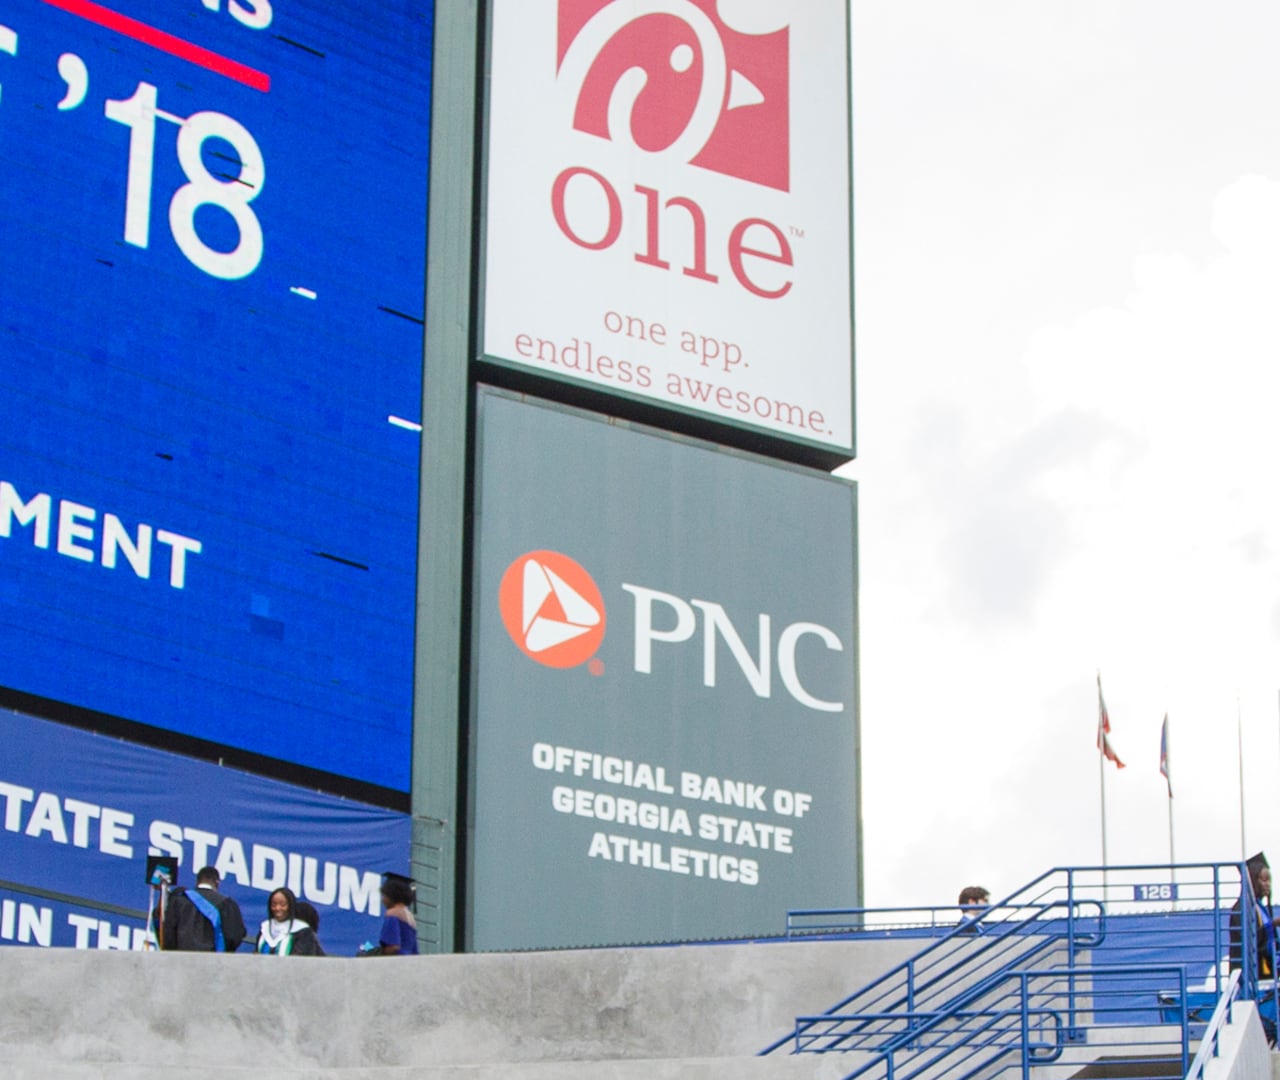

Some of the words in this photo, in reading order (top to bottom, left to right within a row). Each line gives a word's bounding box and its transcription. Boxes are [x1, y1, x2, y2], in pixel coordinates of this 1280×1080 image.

[551, 166, 794, 300] one
[604, 311, 666, 345] one
[680, 330, 750, 371] app.
[515, 333, 652, 388] endless
[666, 373, 833, 436] awesome.
[621, 582, 844, 713] PNC
[532, 742, 674, 795] OFFICIAL
[681, 771, 767, 811] BANK
[773, 789, 812, 818] OF
[552, 786, 692, 836] GEORGIA
[699, 814, 793, 854] STATE
[148, 820, 382, 917] STADIUM
[587, 832, 760, 886] ATHLETICS
[1140, 885, 1171, 900] 126
